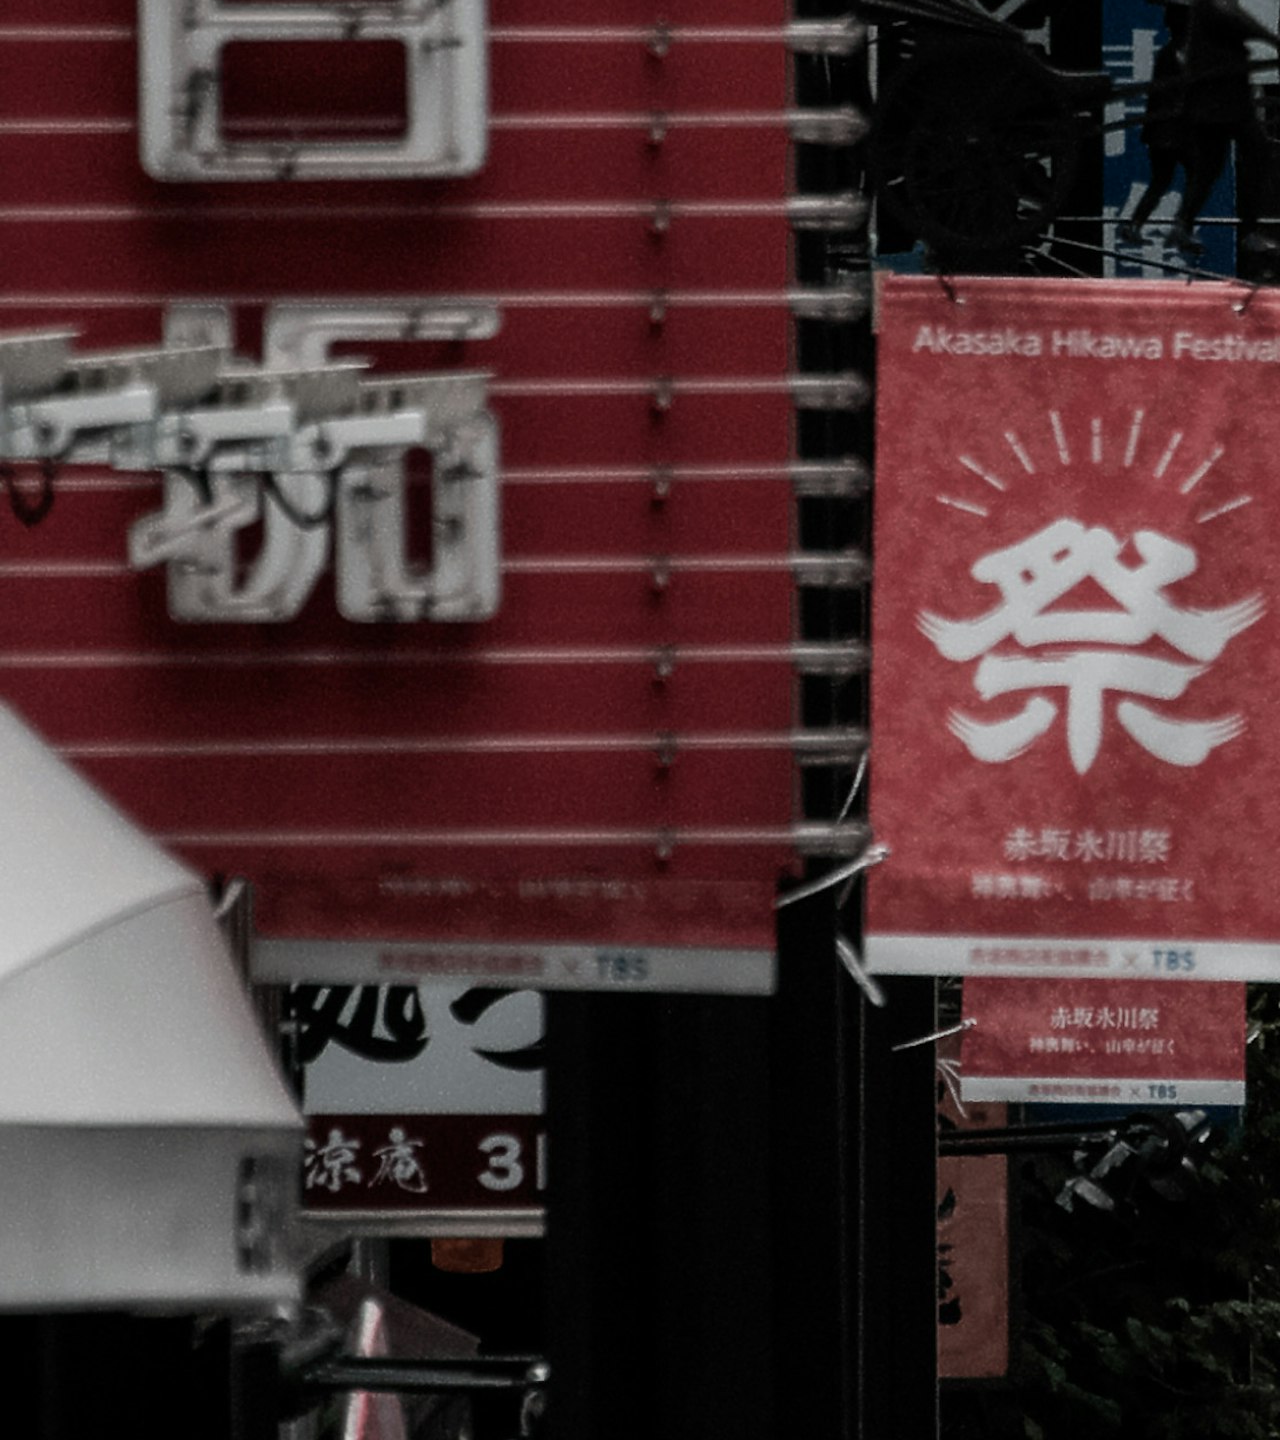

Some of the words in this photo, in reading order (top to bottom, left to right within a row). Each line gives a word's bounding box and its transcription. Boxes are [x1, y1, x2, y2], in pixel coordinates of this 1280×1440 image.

[912, 324, 1043, 358] Akasaka
[1050, 328, 1164, 361] Hikawa
[914, 519, 1270, 776] 祭
[1003, 828, 1172, 864] 赤坂氷川祭
[1151, 948, 1197, 972] TBS
[1049, 1006, 1160, 1031] 赤坂氷川祭
[1148, 1084, 1178, 1100] TBS
[476, 1132, 547, 1193] 3
